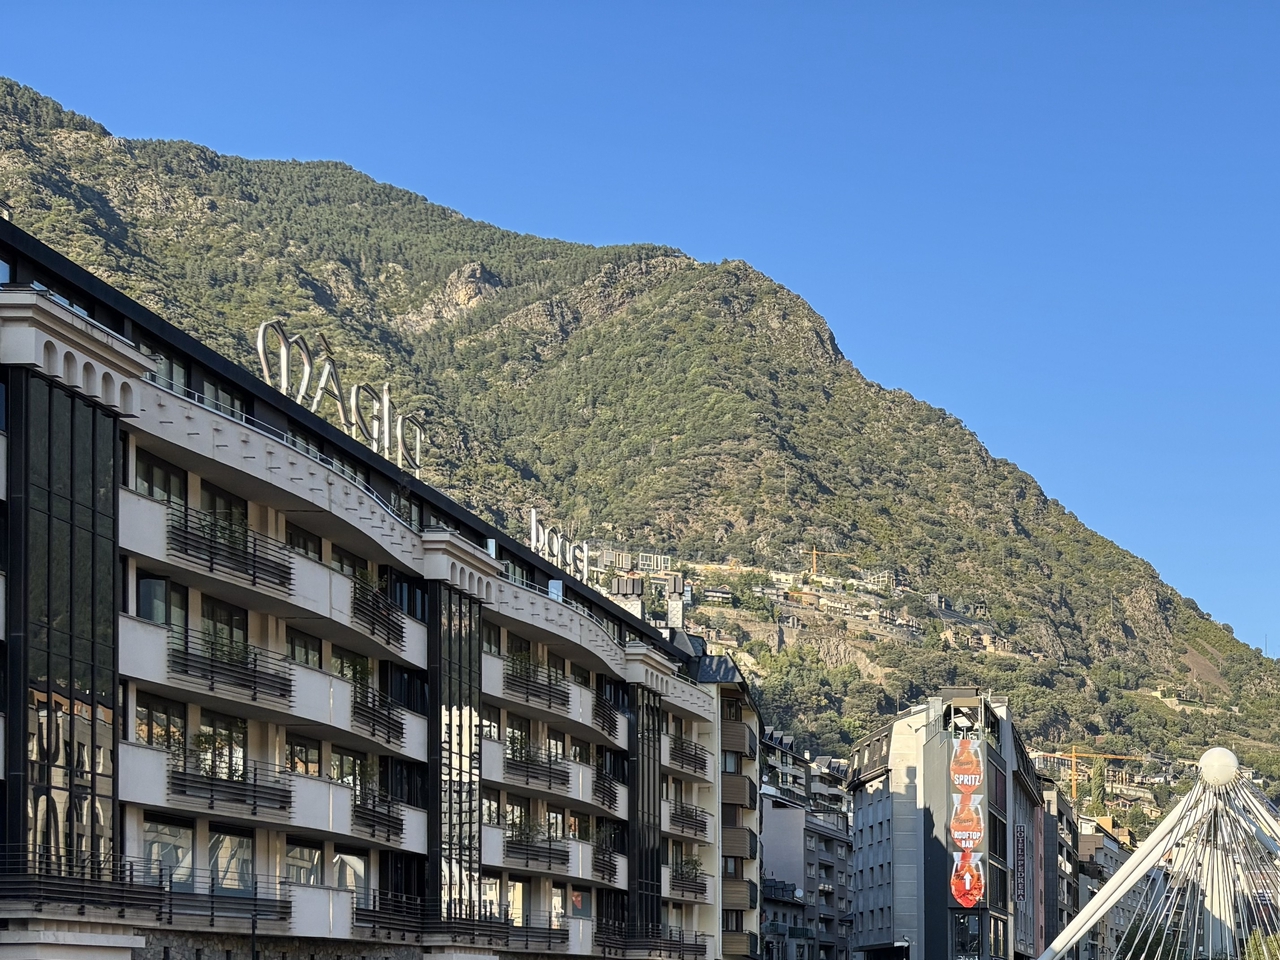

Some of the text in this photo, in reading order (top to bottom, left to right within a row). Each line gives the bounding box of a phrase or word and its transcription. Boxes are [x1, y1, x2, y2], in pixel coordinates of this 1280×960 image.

[954, 774, 980, 785] SPRITZ
[954, 831, 980, 839] ROOFTOP
[961, 840, 973, 848] BAR
